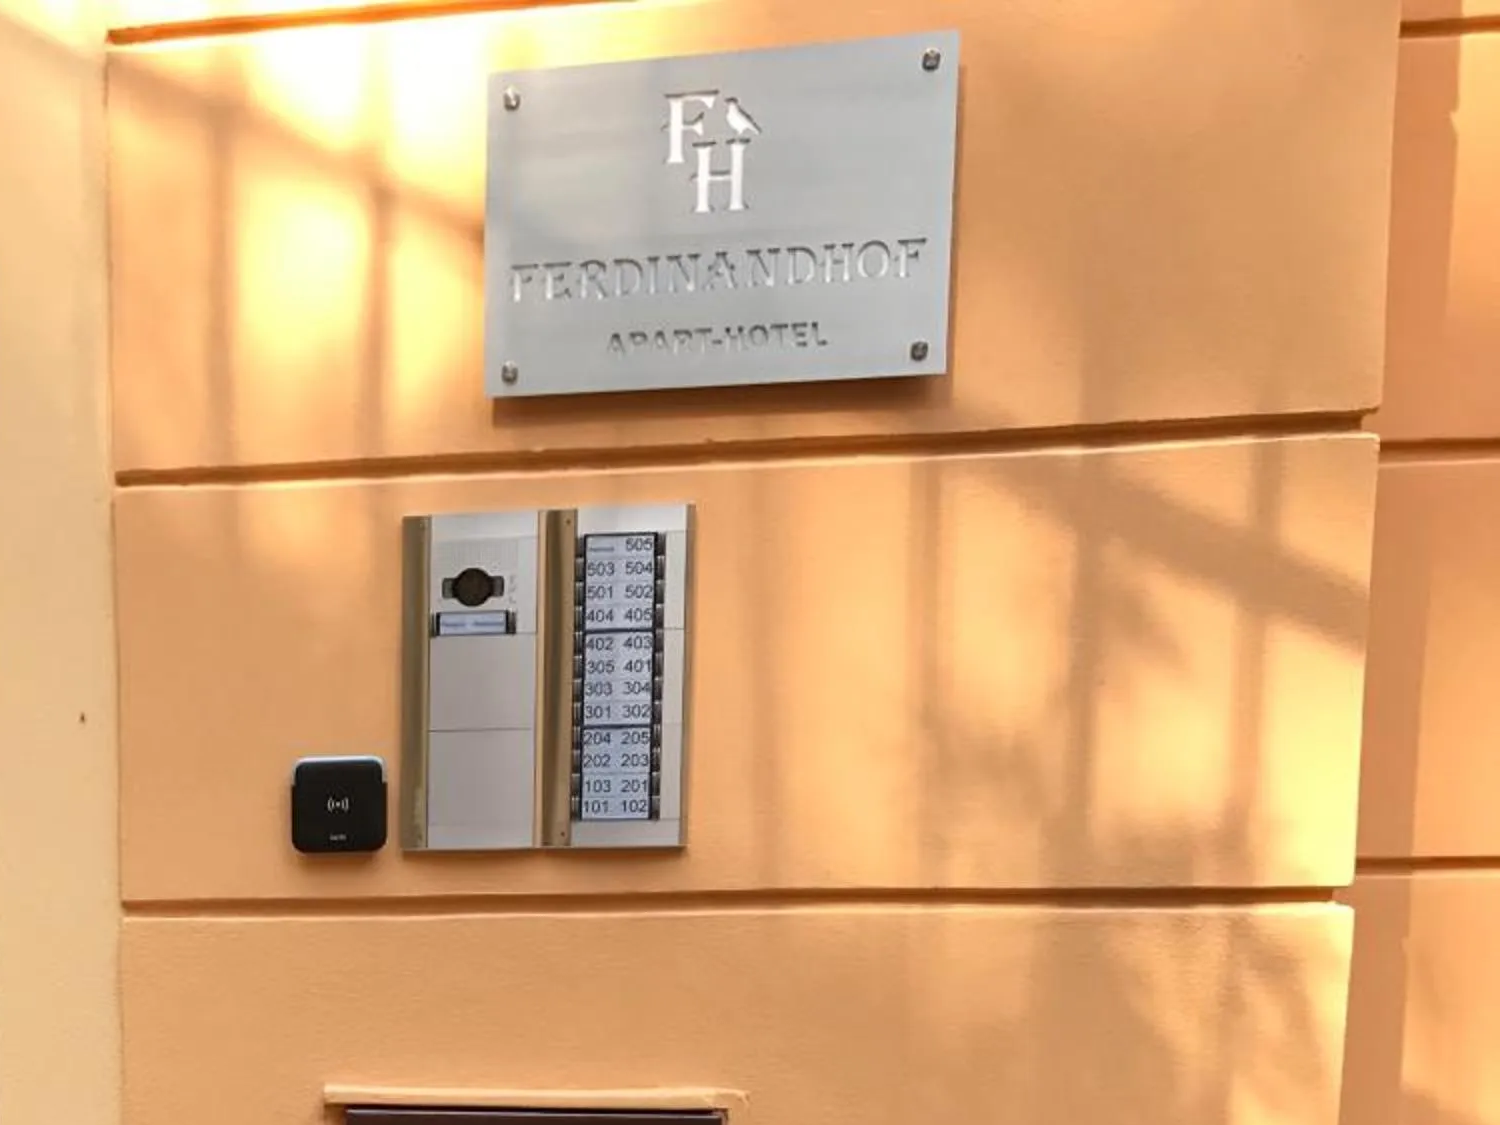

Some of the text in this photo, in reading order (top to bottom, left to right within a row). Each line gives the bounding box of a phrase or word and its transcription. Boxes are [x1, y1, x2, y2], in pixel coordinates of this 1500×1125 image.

[508, 237, 927, 303] FERDINANDHOF
[605, 320, 828, 357] APART-HOTEL
[587, 561, 652, 576] 503 504
[587, 584, 652, 599] 501 502
[586, 608, 652, 622] 404 405
[586, 635, 652, 651] 402 403
[586, 659, 651, 674] 305 401
[622, 681, 650, 695] 304
[585, 704, 650, 719] 301 302
[584, 730, 650, 745] 204 205
[583, 753, 649, 768] 202 203
[585, 779, 648, 793] 103 201
[584, 800, 647, 813] 101 102
